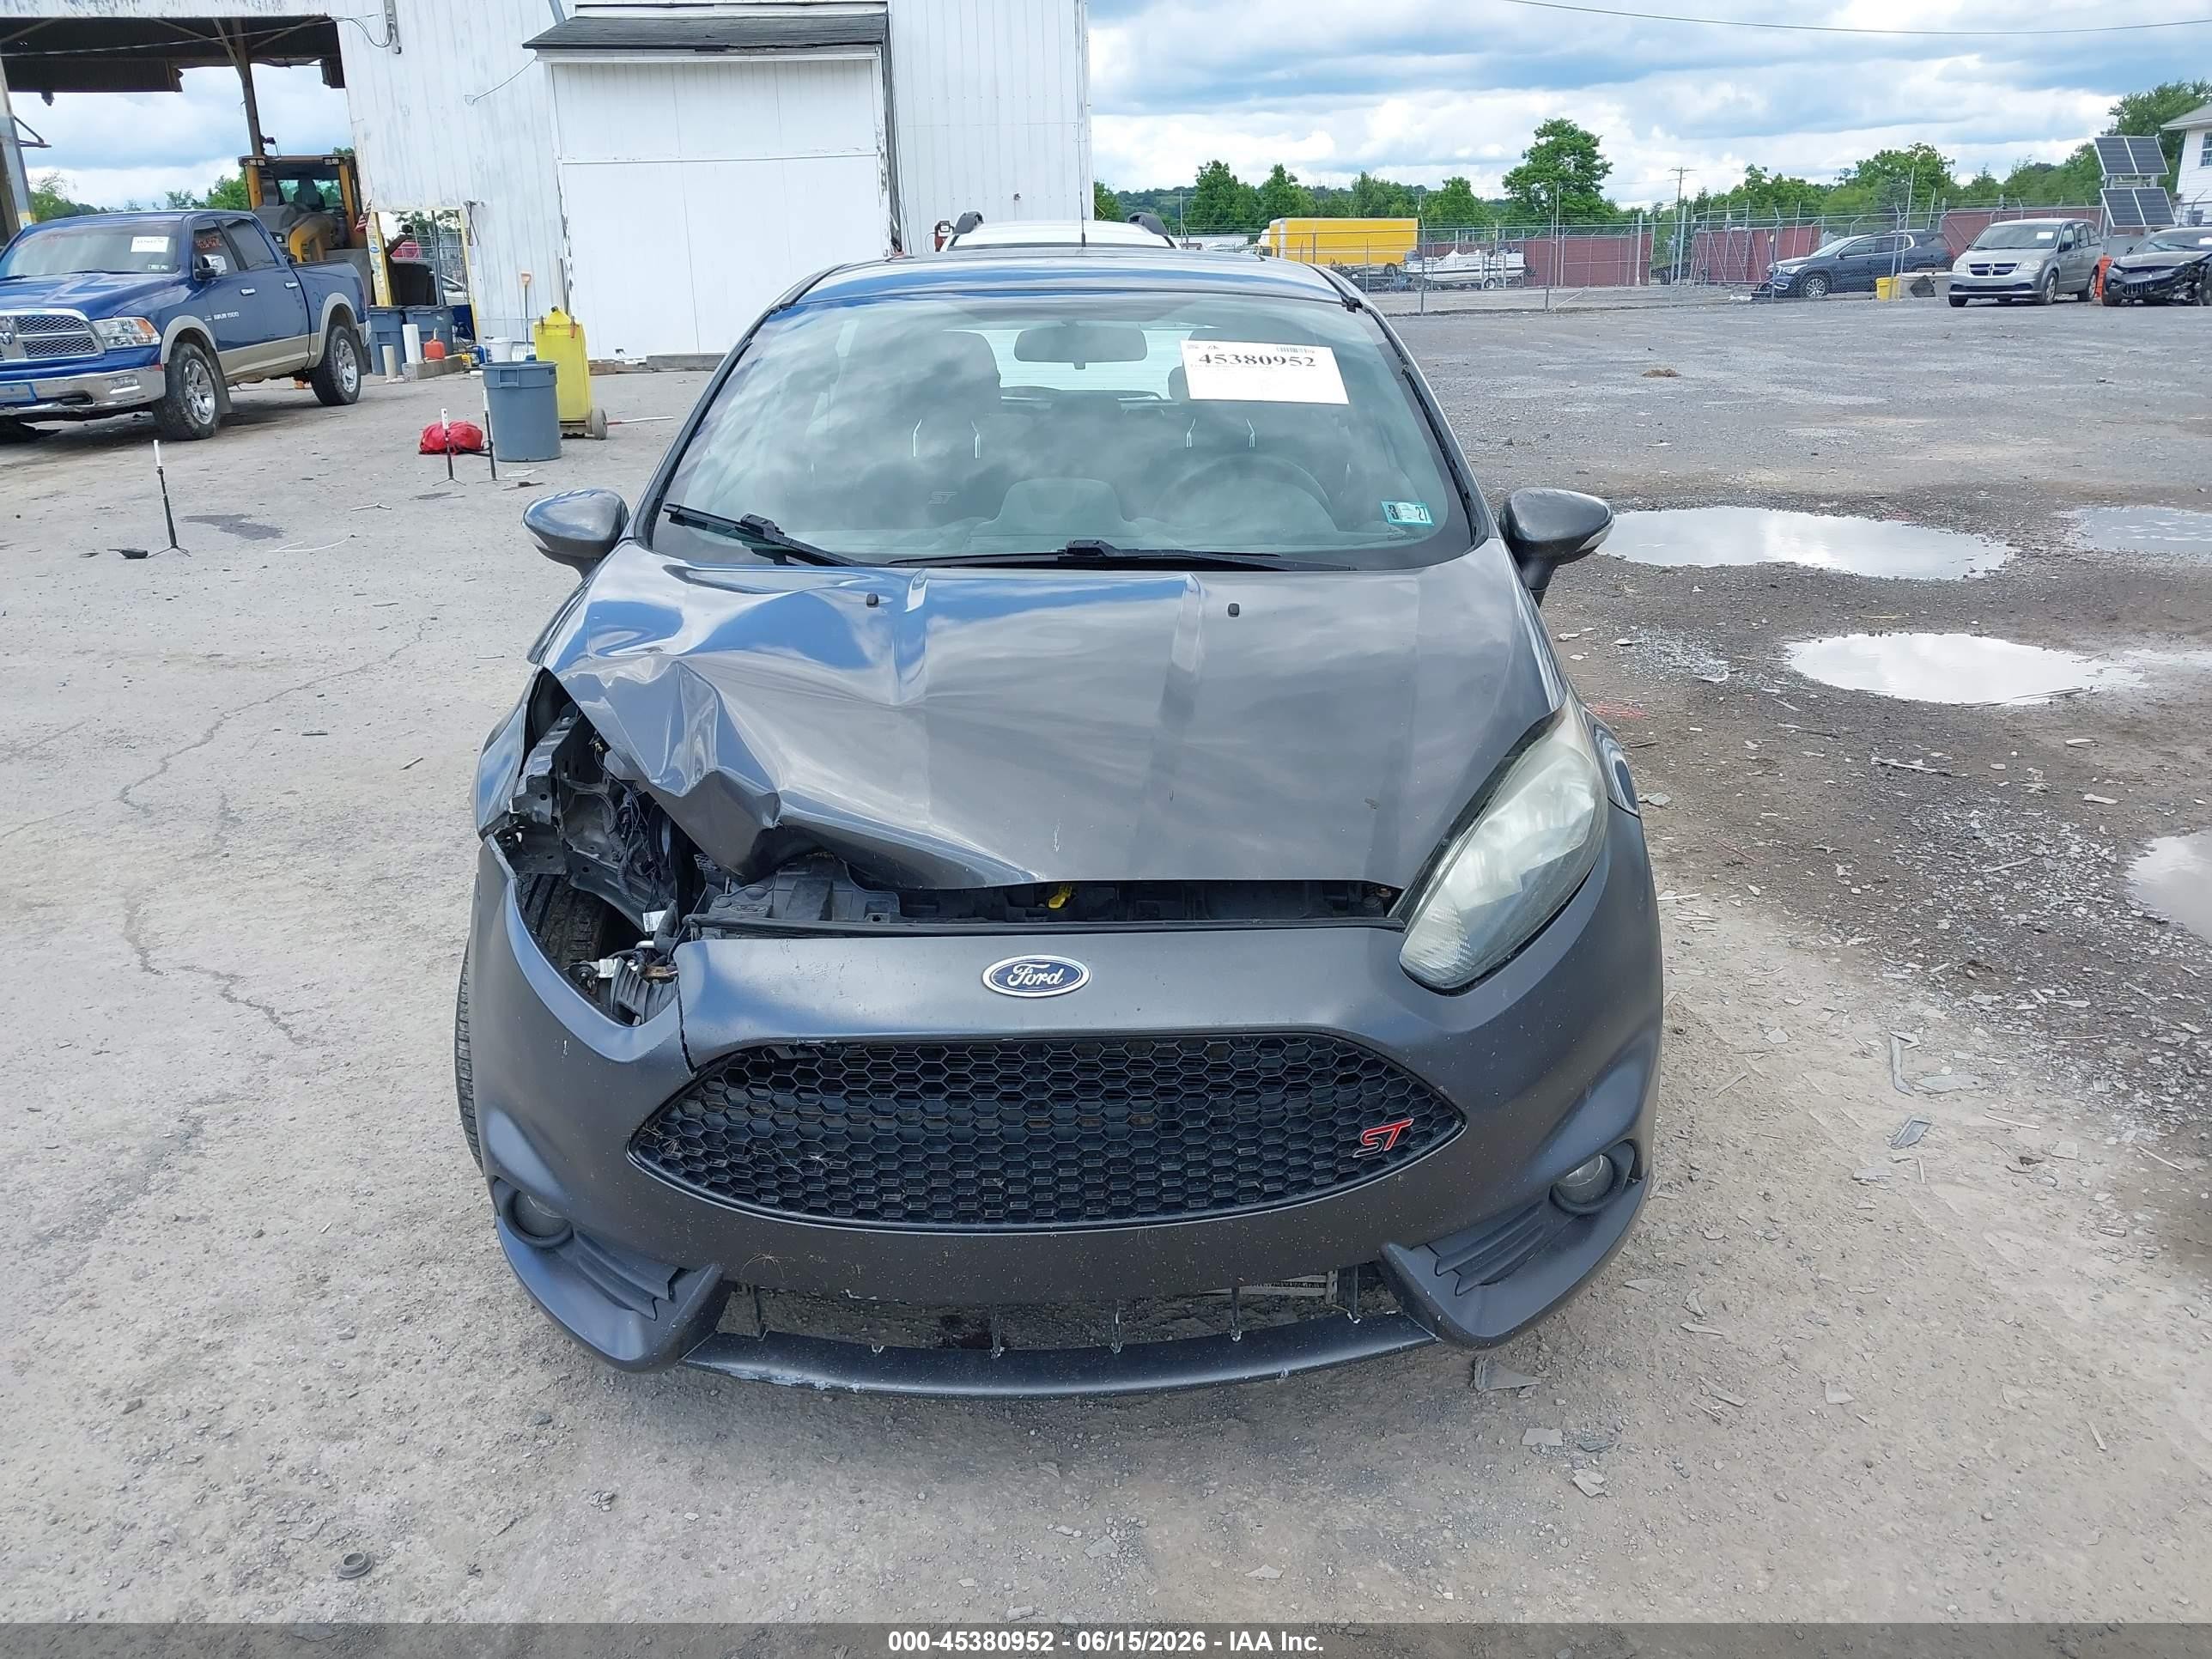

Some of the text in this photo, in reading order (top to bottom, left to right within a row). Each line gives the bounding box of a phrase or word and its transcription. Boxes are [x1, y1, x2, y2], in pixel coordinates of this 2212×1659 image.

[1199, 353, 1316, 368] 45380952
[1006, 963, 1065, 987] Ford
[1352, 1117, 1415, 1158] ST
